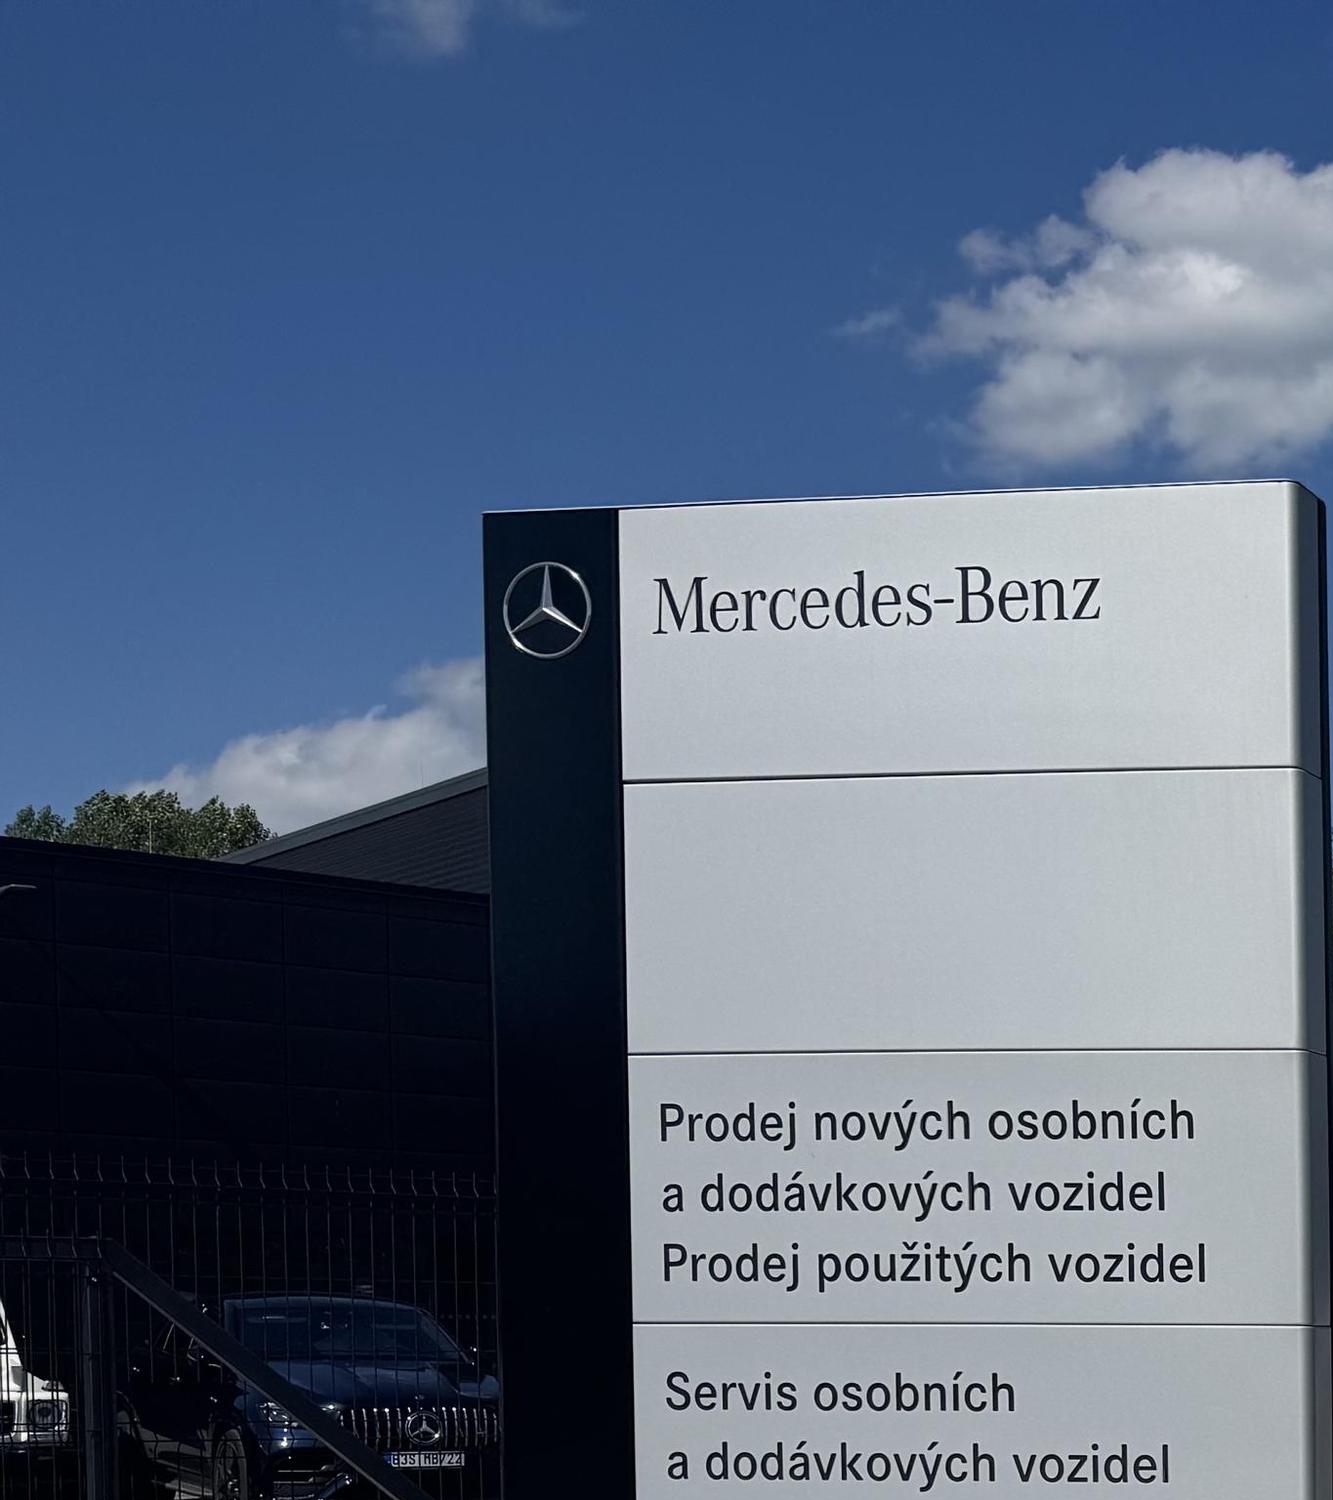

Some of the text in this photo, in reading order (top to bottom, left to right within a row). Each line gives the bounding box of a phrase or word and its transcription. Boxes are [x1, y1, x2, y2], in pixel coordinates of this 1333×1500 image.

[652, 566, 1101, 635] Mercedes-Benz
[660, 1097, 1195, 1152] Prodej nových osobních
[662, 1170, 1165, 1223] a dodávkových vozidel
[663, 1241, 1207, 1294] Prodej použitých vozidel
[665, 1370, 1015, 1413] Servis osobních
[667, 1440, 1170, 1493] a dodávkových vozidel
